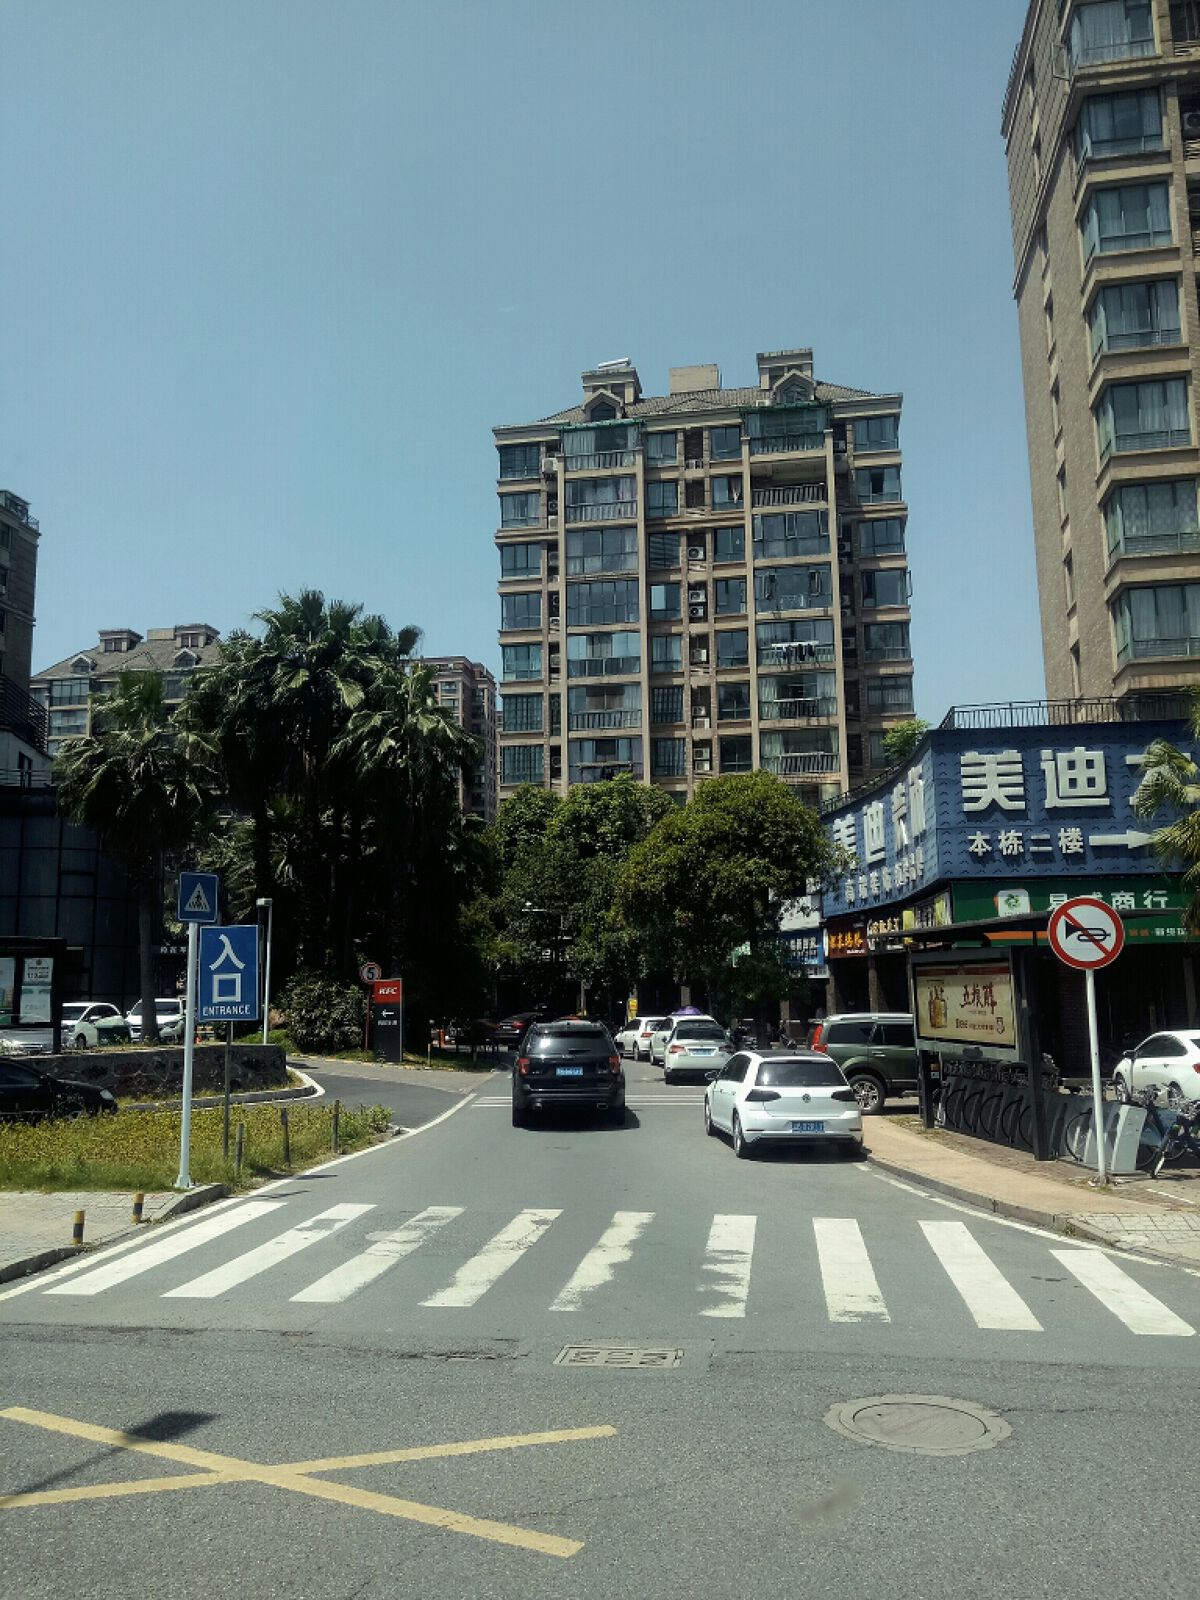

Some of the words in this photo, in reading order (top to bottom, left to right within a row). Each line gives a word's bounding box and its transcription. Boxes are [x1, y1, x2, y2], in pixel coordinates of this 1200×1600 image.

[968, 827, 1084, 856] 本栋二楼
[209, 934, 246, 1003] 入口
[367, 967, 375, 980] 5
[379, 987, 398, 995] KFC
[202, 1004, 251, 1016] ENTRANCE
